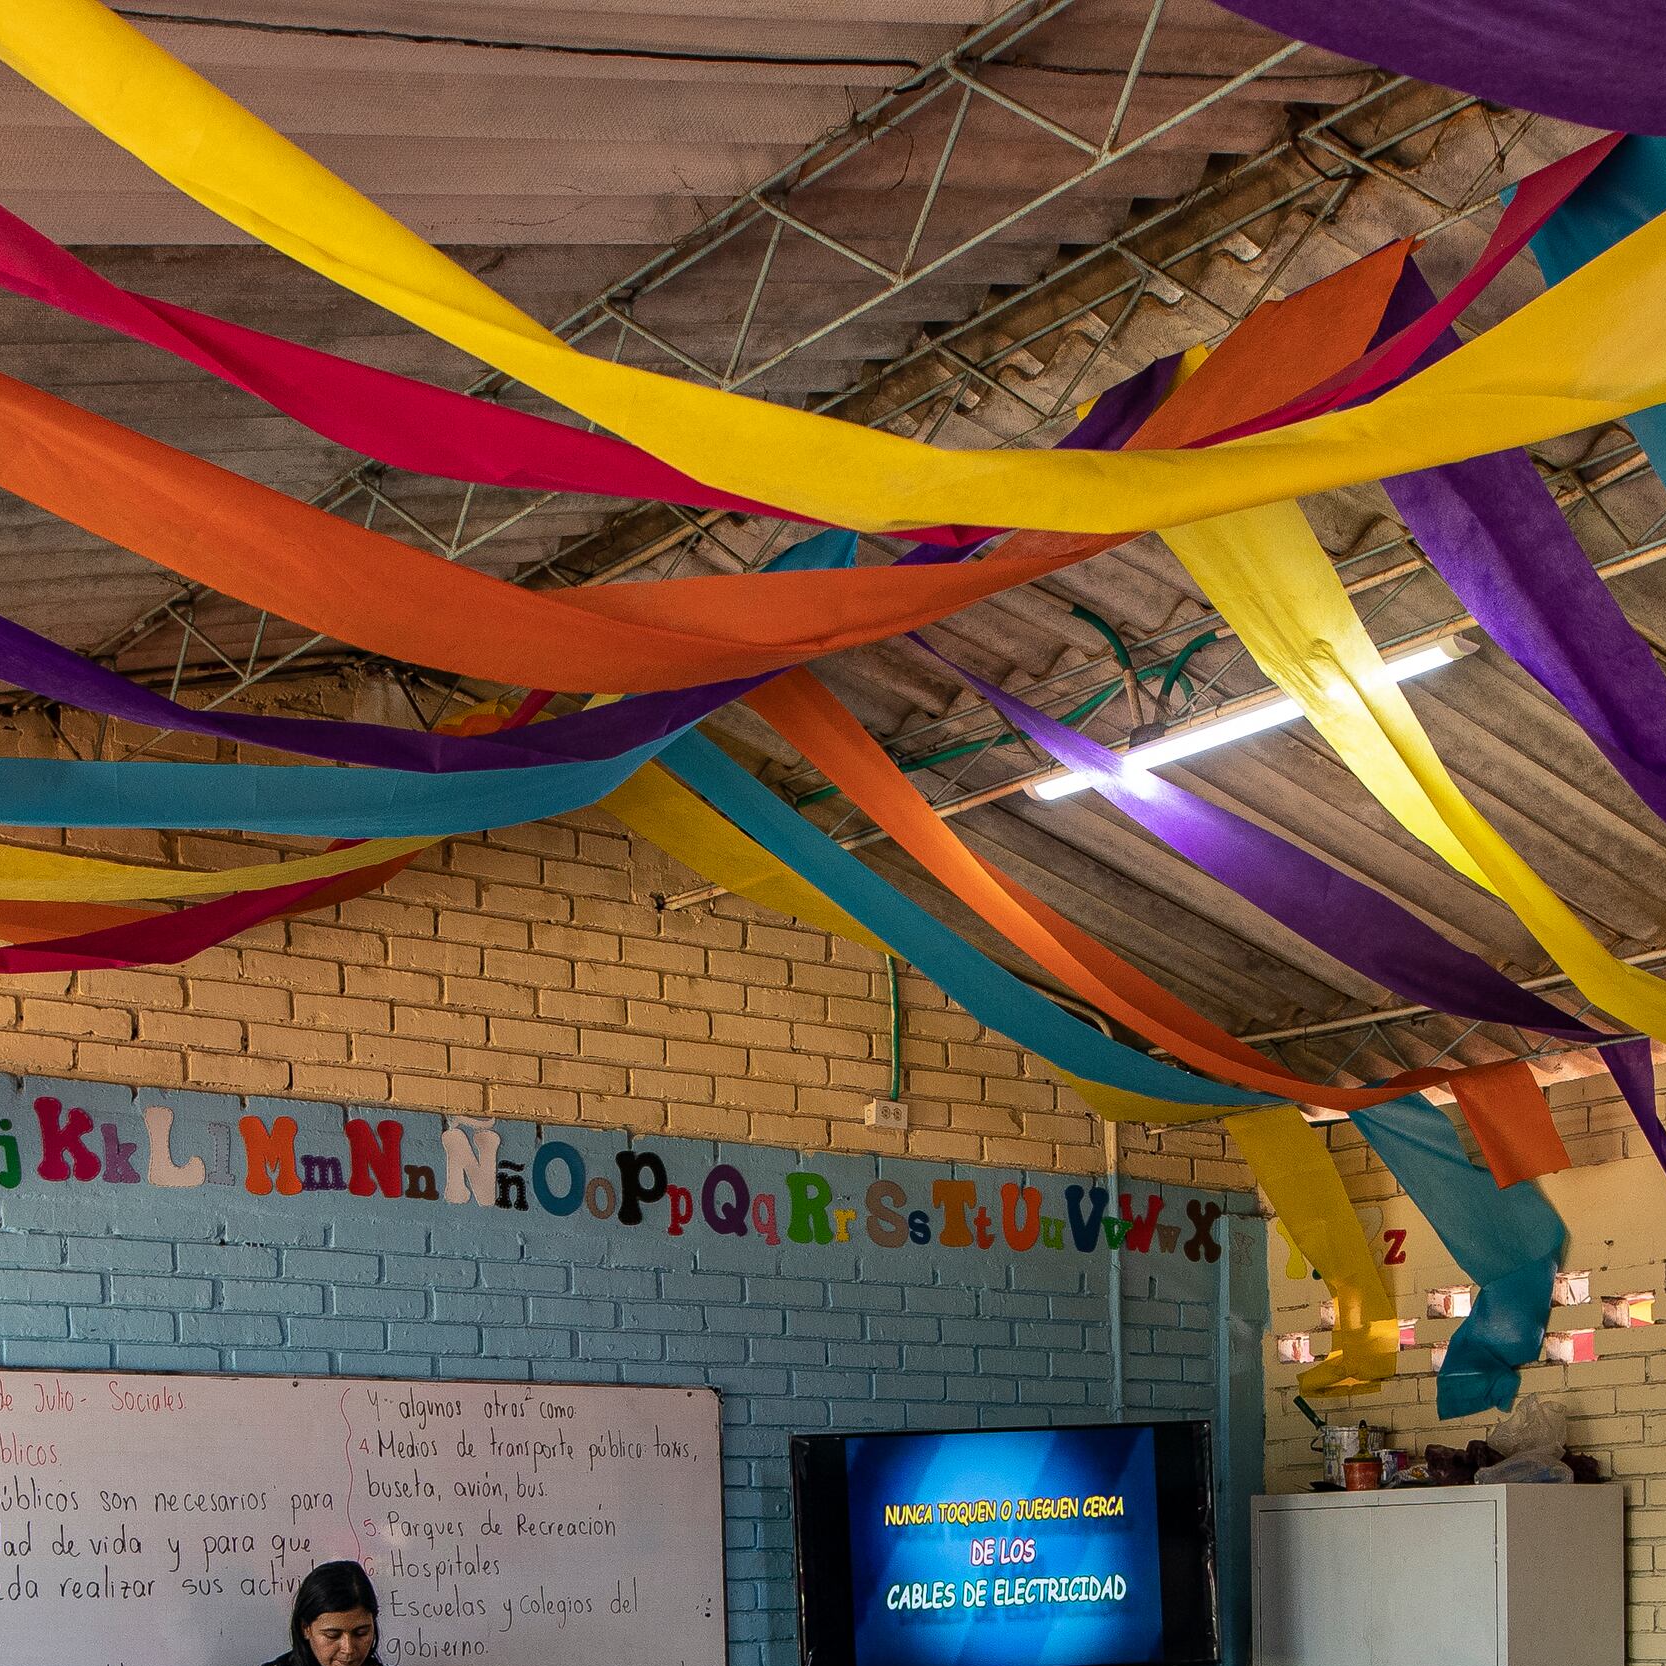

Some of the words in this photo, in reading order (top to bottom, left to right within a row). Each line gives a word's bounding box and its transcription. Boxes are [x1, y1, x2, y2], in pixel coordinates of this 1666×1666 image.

[399, 1387, 461, 1430] algunos
[484, 1389, 525, 1418] otros
[377, 1429, 437, 1459] Medios
[456, 1429, 477, 1458] de
[490, 1426, 574, 1473] transporte
[366, 1468, 441, 1501] buseta,
[454, 1471, 508, 1502] avión,
[517, 1471, 548, 1500] bus.
[101, 1488, 137, 1512] son
[154, 1486, 267, 1513] necesarios
[291, 1491, 334, 1523] para
[884, 1502, 933, 1526] NUNCA
[938, 1500, 997, 1527] TOQUEN
[1001, 1500, 1012, 1521] O
[1016, 1497, 1079, 1521] JUEGUEN
[1082, 1496, 1125, 1518] CERCA
[387, 1510, 465, 1551] Parques
[480, 1508, 505, 1538] de
[516, 1502, 617, 1538] Recreación
[52, 1525, 81, 1559] de
[90, 1524, 143, 1555] vida
[168, 1538, 183, 1573] y
[203, 1534, 255, 1572] para
[272, 1534, 312, 1569] que
[971, 1539, 995, 1566] DE
[1000, 1537, 1036, 1564] LOS
[60, 1565, 156, 1599] realizar
[181, 1575, 224, 1596] sus
[390, 1543, 502, 1592] Hospitales
[389, 1585, 487, 1619] Escuelas
[610, 1584, 639, 1616] del
[886, 1581, 956, 1610] CABLES
[962, 1579, 987, 1607] DE
[993, 1574, 1127, 1606] ELECTRICIDAD
